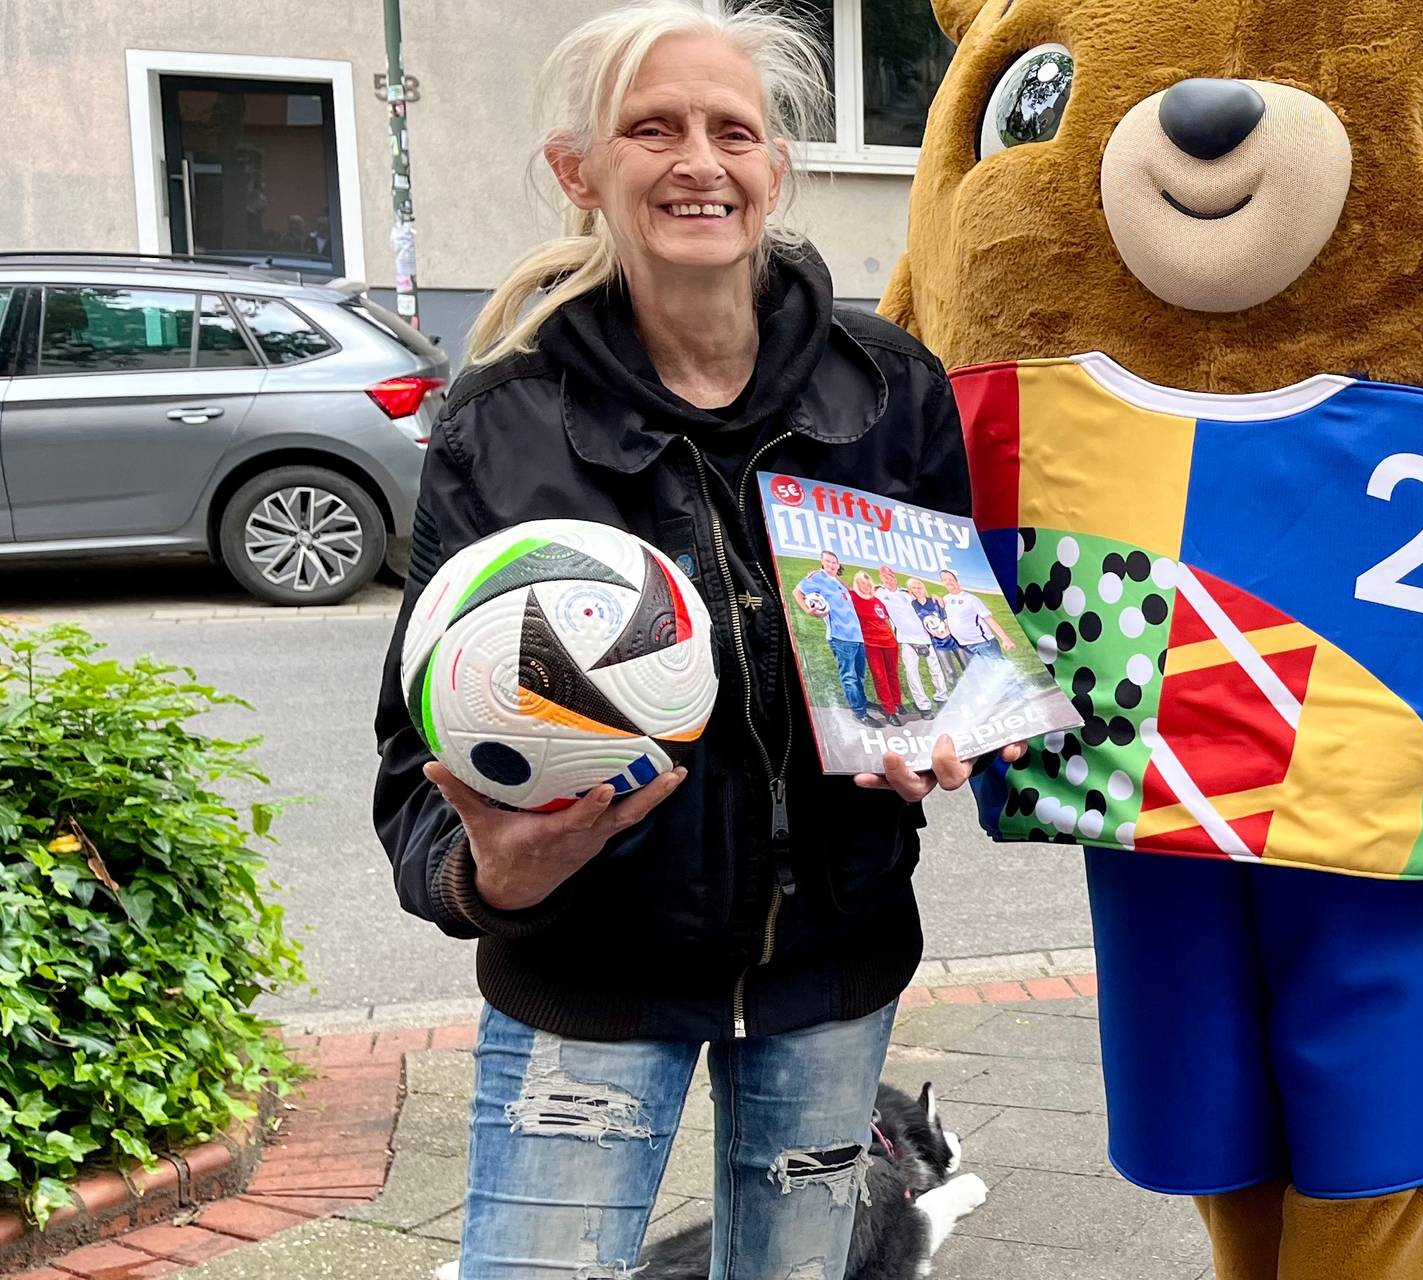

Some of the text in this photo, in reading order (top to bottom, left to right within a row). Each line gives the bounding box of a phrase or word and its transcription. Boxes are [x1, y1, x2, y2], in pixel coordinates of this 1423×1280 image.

[374, 73, 420, 102] 58
[776, 483, 800, 498] 5€
[812, 486, 970, 549] fiftyfifty
